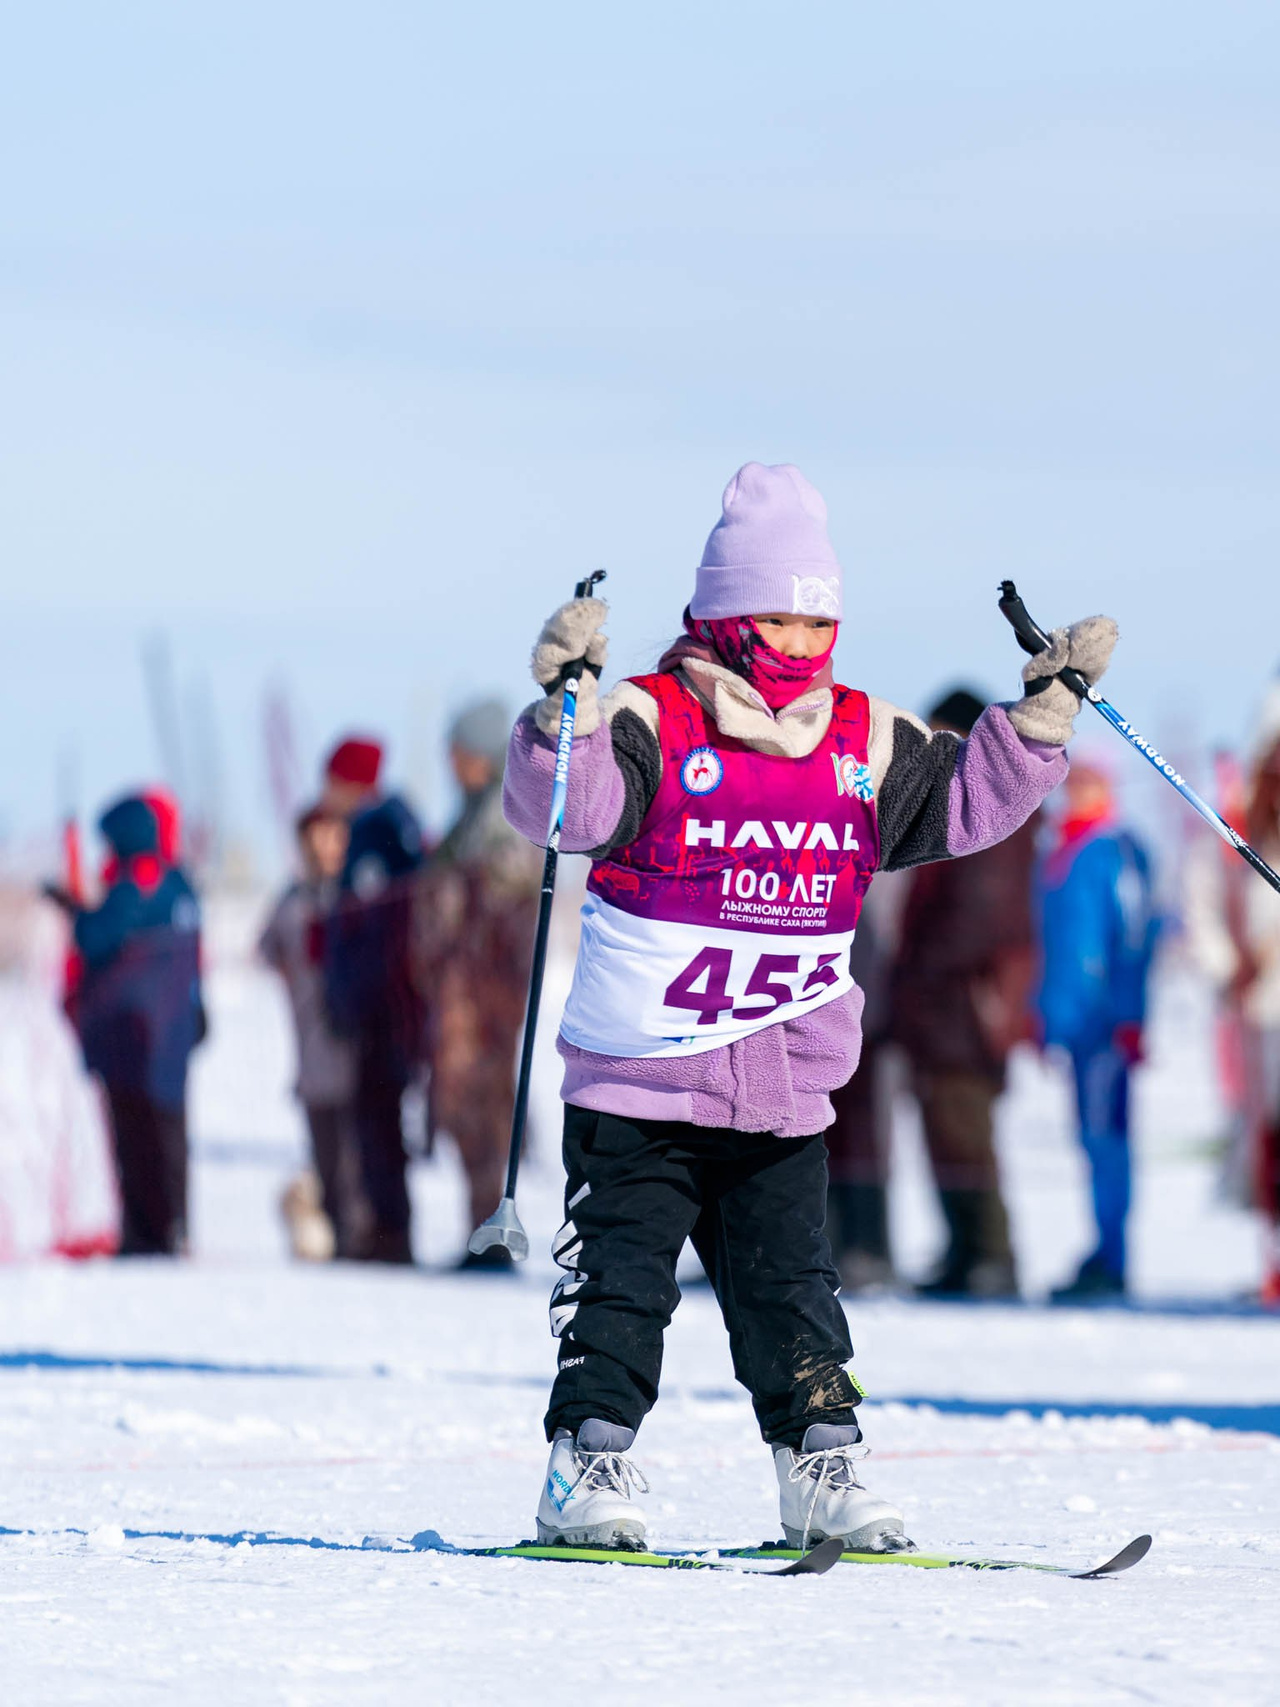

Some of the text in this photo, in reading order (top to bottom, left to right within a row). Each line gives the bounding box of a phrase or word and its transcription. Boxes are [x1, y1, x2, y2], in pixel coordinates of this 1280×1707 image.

[555, 713, 574, 784] NORDWAY
[1117, 721, 1185, 786] NORDWAY
[685, 819, 859, 851] HAVAL
[720, 868, 837, 904] 100 ЛЕТ
[719, 912, 725, 920] В
[726, 913, 780, 927] РЕСПУБЛИКЕ
[781, 918, 800, 927] САХА
[721, 900, 828, 918] ЛЫЖНОМУ СПОРТУ
